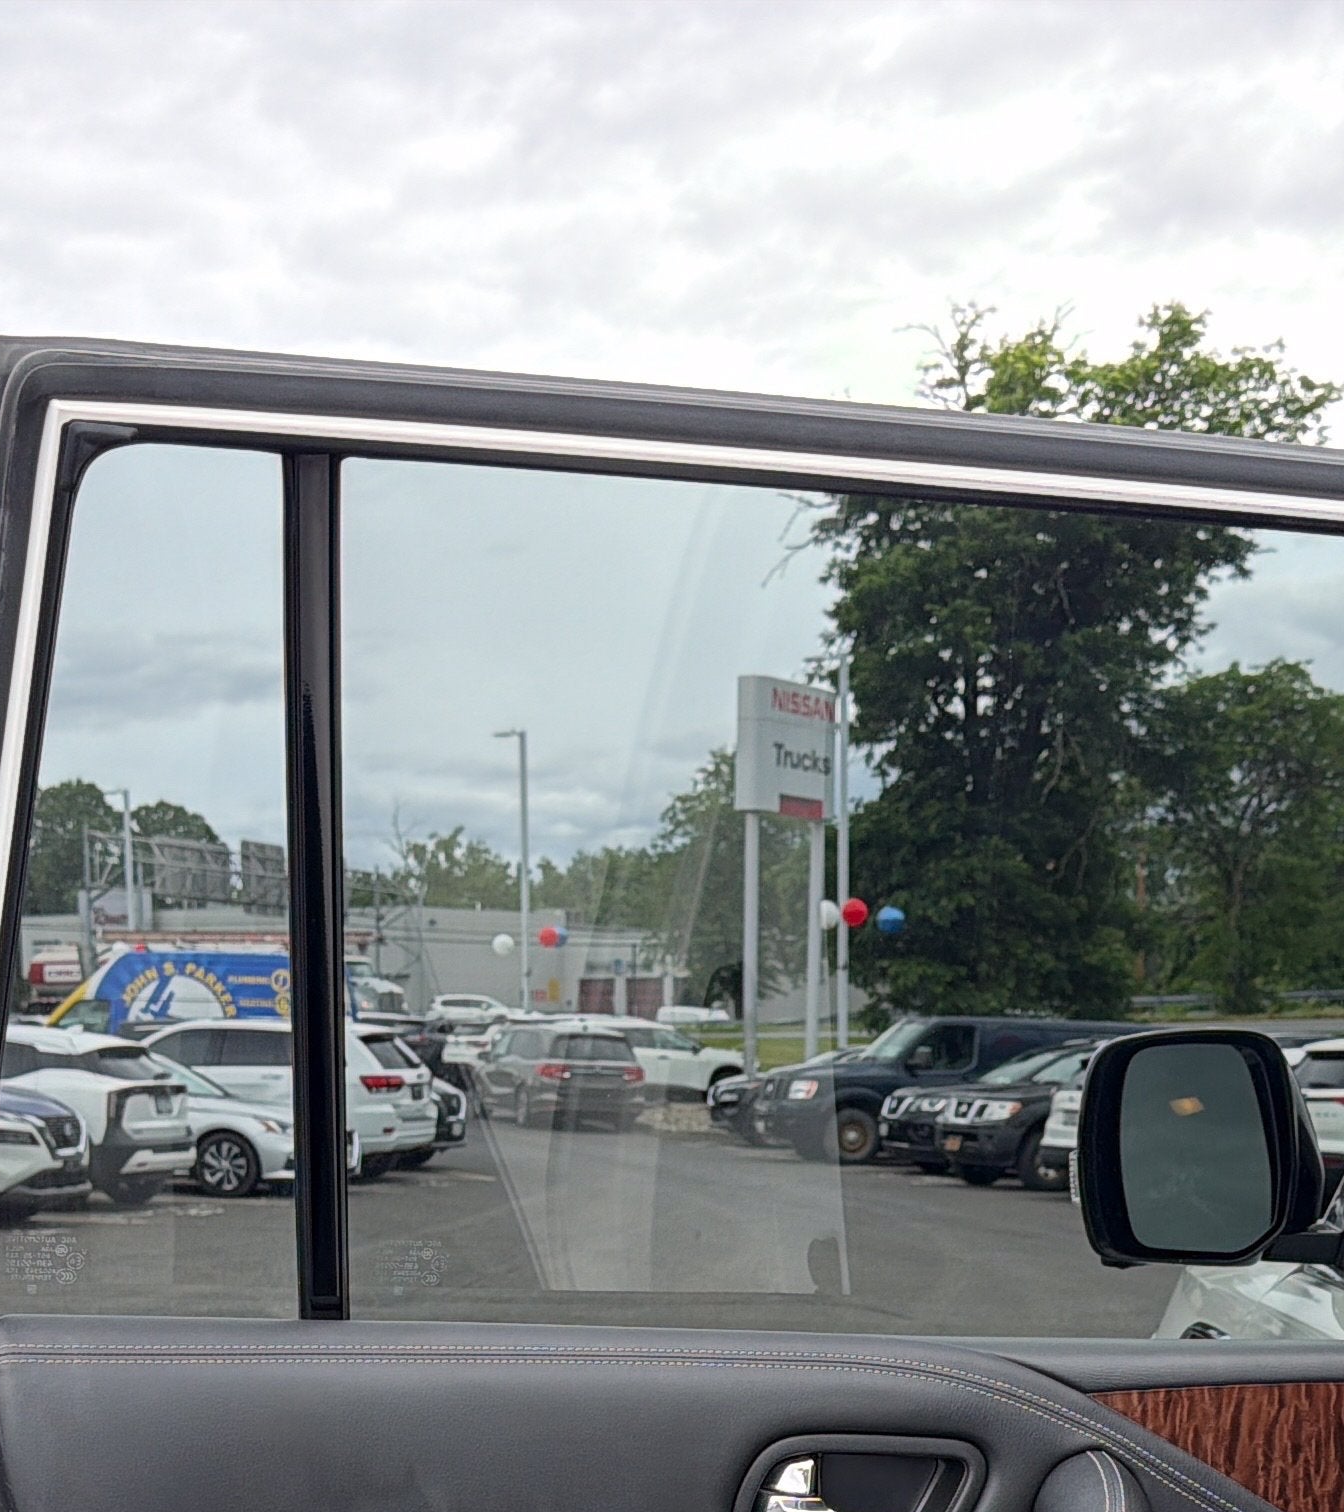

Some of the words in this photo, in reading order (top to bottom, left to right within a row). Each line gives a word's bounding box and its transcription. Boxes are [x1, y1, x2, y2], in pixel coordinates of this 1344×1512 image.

[772, 687, 835, 723] NISSAN
[773, 742, 831, 776] Trucks
[123, 967, 159, 1007] JOHN
[185, 962, 237, 1018] PARKER
